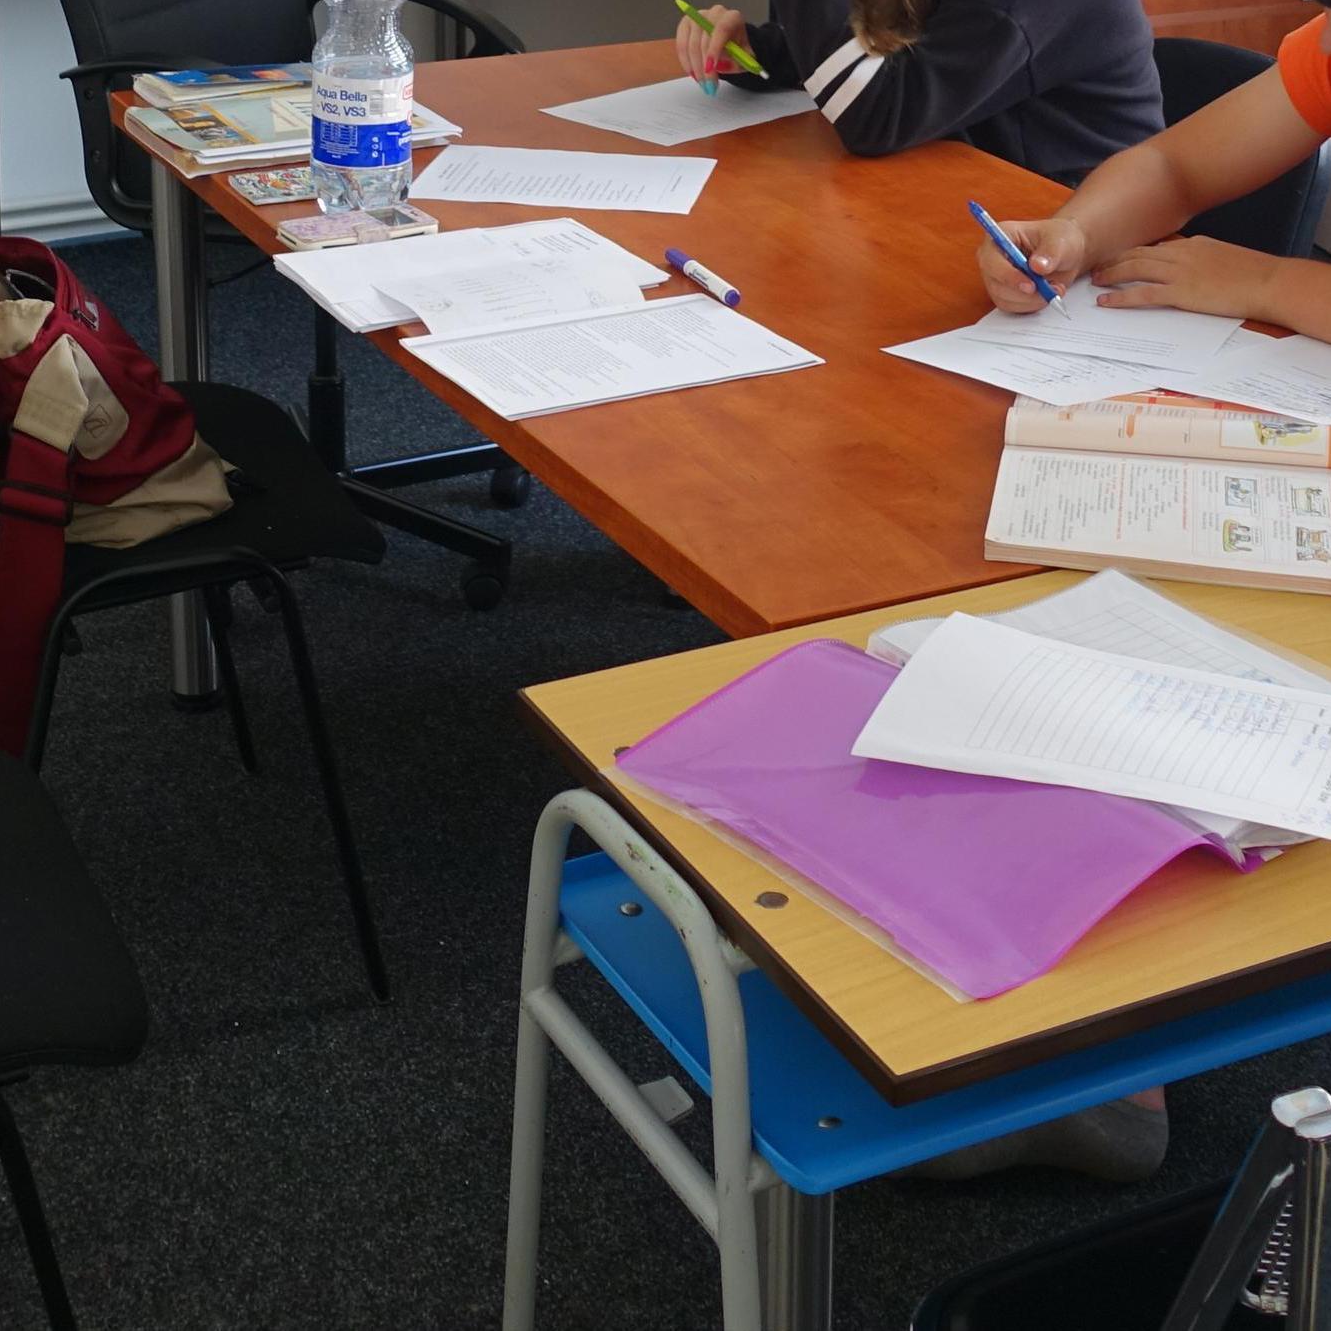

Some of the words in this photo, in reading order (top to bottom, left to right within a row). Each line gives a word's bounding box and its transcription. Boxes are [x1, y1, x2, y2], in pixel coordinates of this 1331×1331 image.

[317, 85, 338, 100] Aqua
[339, 90, 368, 102] Bella
[321, 101, 341, 116] VS2,
[343, 105, 367, 117] VS3
